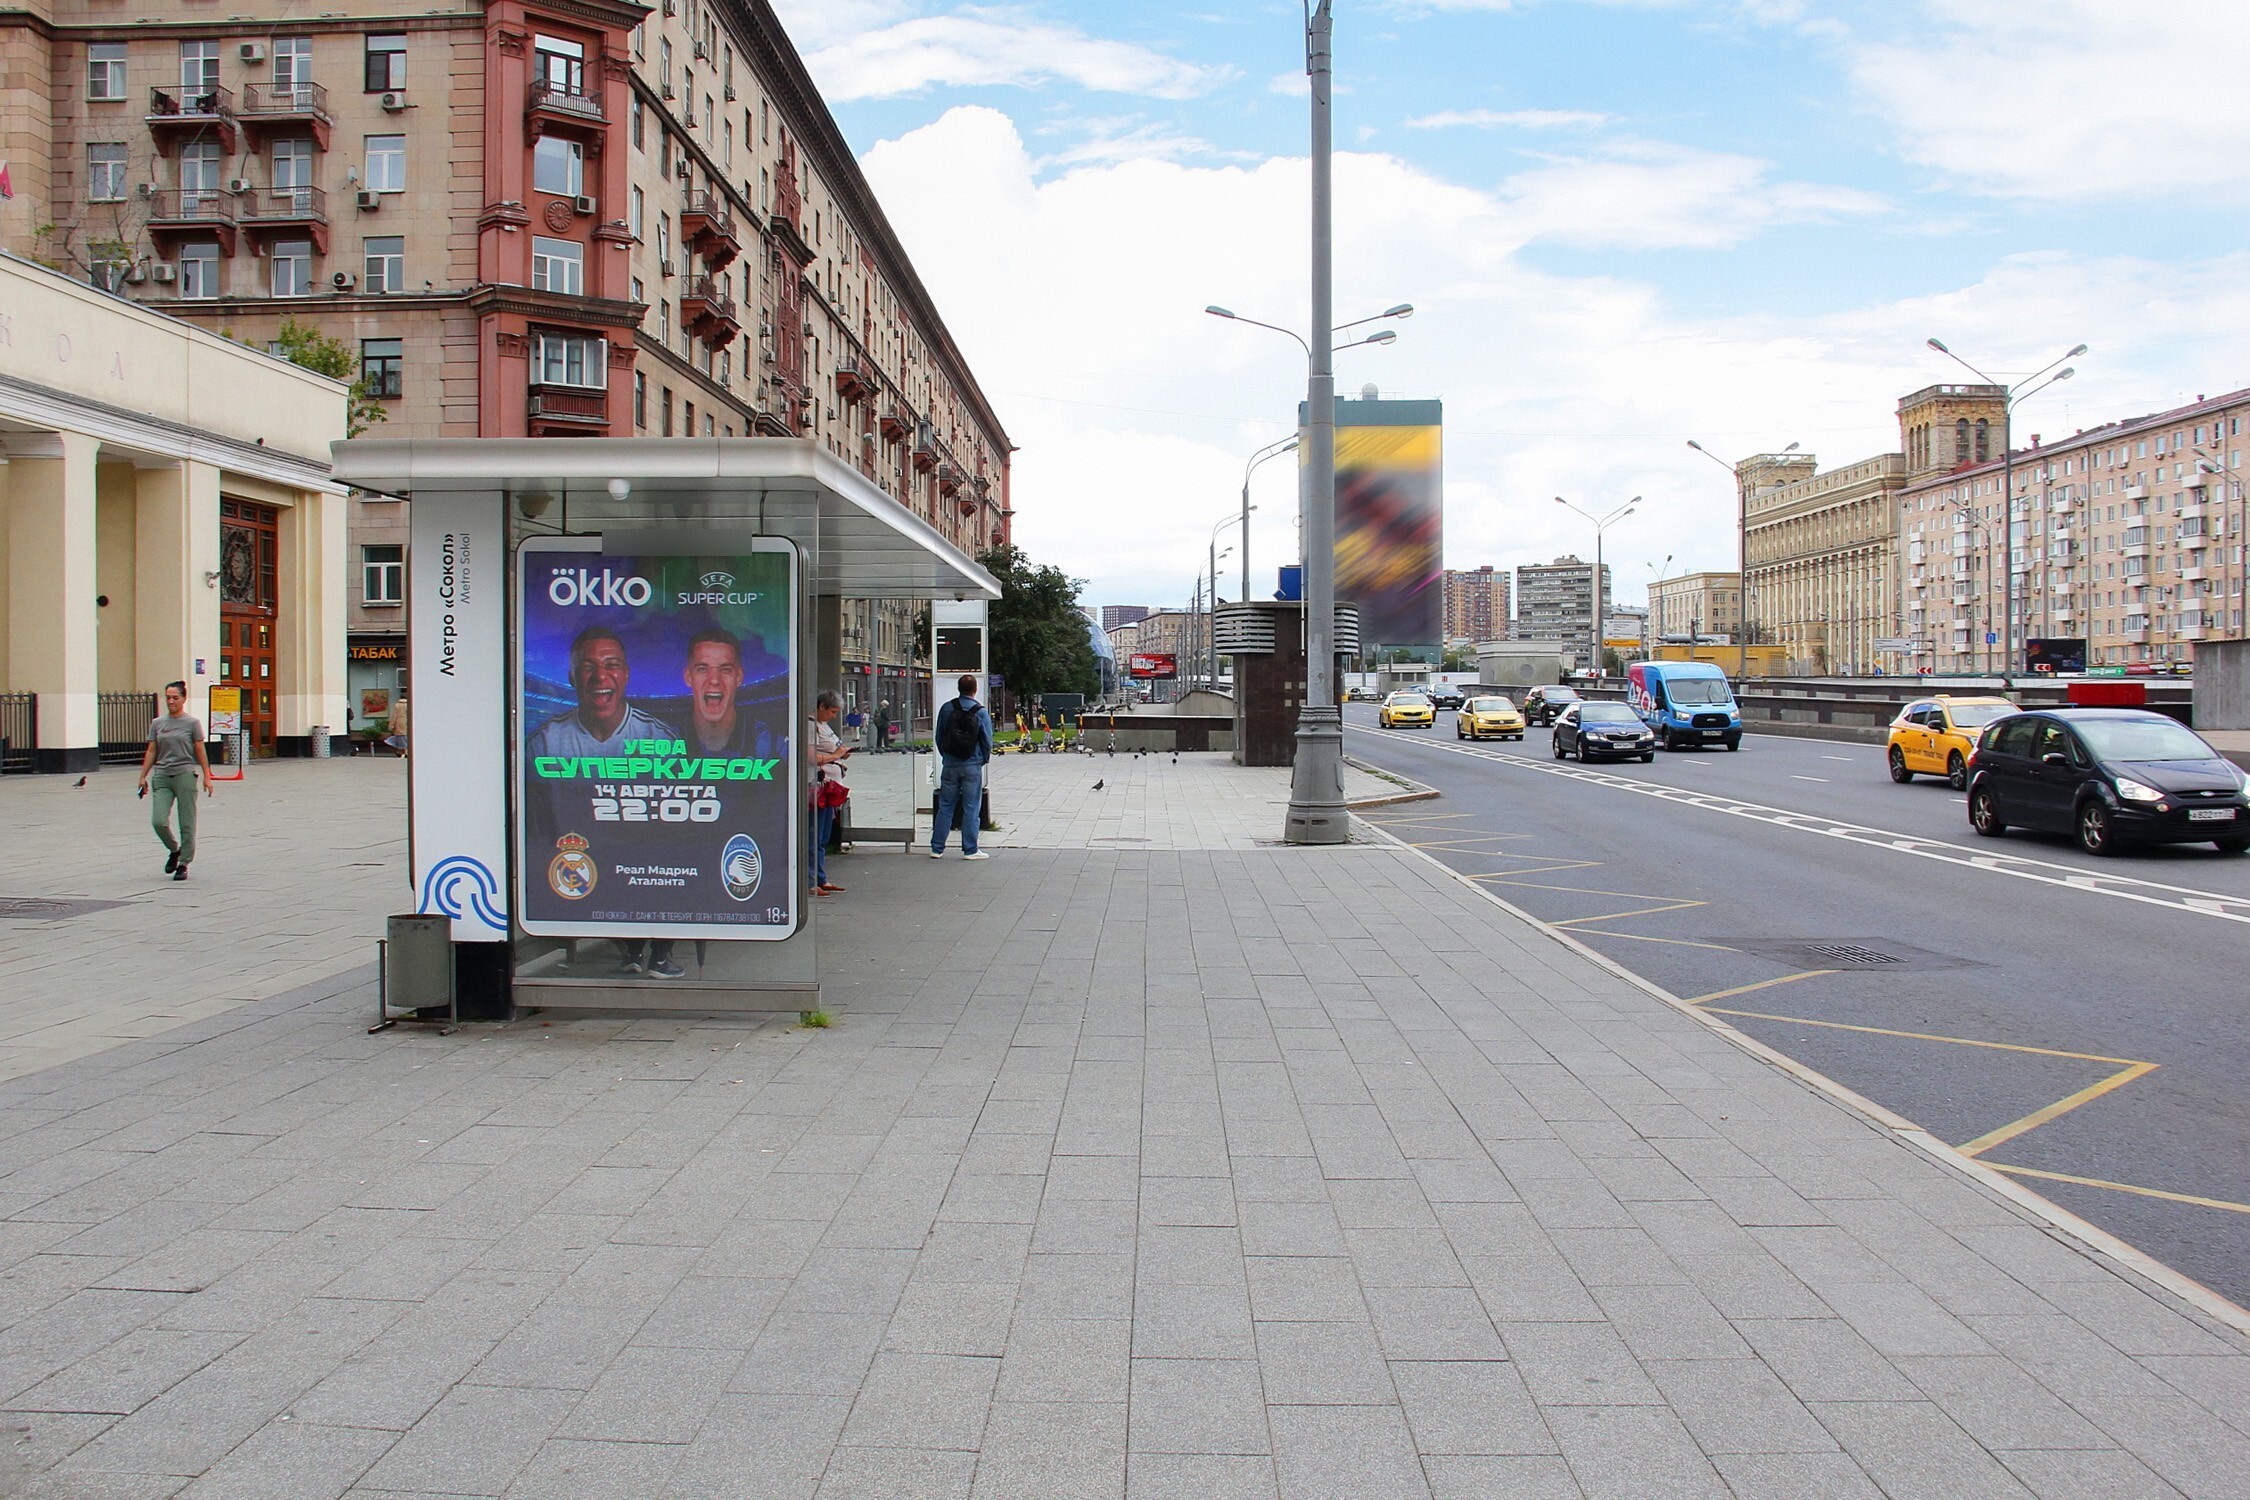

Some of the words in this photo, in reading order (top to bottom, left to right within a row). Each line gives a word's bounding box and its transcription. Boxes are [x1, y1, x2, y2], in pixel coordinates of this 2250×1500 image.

[459, 533, 471, 565] Sokol
[439, 533, 454, 608] «Сокол»
[460, 567, 471, 604] Metro
[700, 574, 733, 587] UEFA
[677, 592, 725, 605] SUPER
[350, 647, 397, 659] ТАБАК
[440, 614, 458, 677] Метро
[624, 739, 687, 757] УЕФА
[534, 757, 780, 780] СУПЕРКУБОК
[594, 784, 617, 797] 14
[619, 785, 717, 798] АВГУСТА
[591, 798, 722, 823] 22:00
[615, 864, 645, 875] Реал
[648, 865, 698, 877] Мадрид
[627, 876, 686, 887] Аталанта
[732, 885, 750, 893] 1907
[766, 907, 788, 923] 18+
